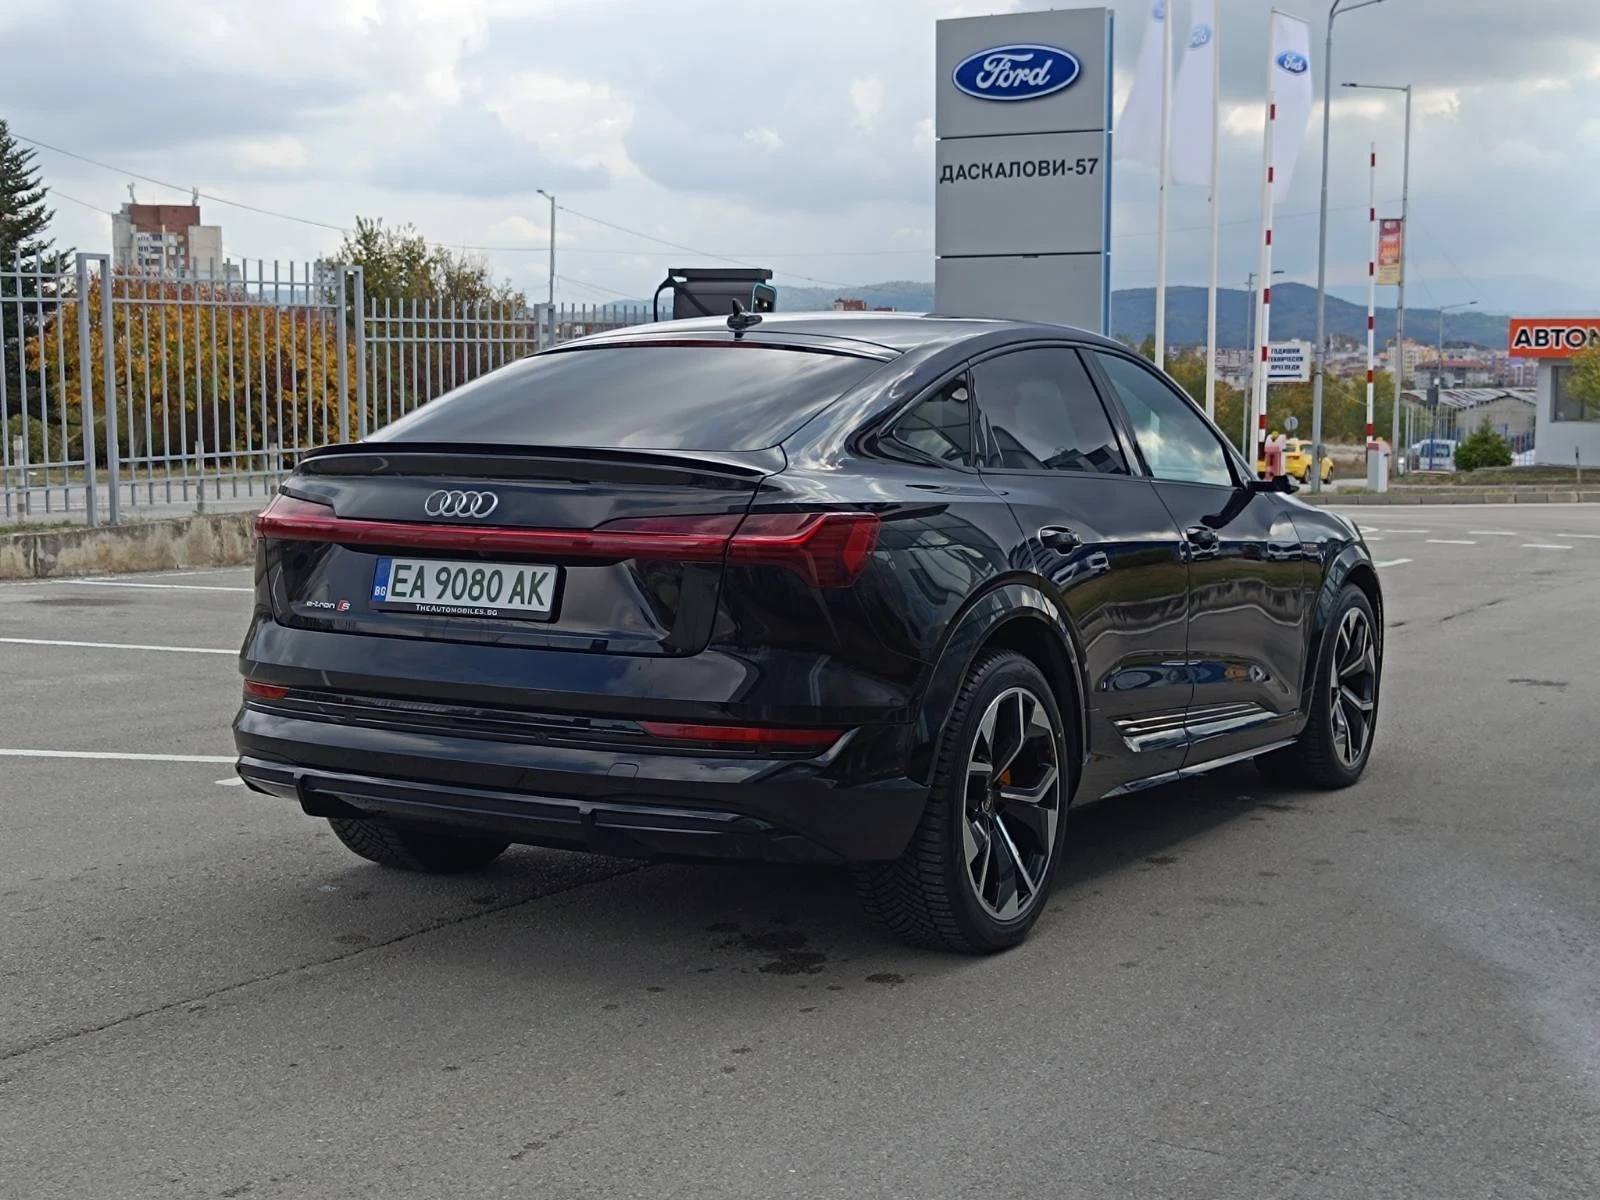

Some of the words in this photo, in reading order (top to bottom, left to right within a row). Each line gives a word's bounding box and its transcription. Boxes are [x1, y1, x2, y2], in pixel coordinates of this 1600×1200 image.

[976, 53, 1053, 89] Ford
[940, 158, 1098, 184] ДАСКАЛОВИ-57
[374, 585, 387, 597] BG
[391, 564, 425, 598] EA
[433, 567, 503, 603] 9080
[508, 571, 549, 606] AK
[306, 600, 336, 609] e-tron
